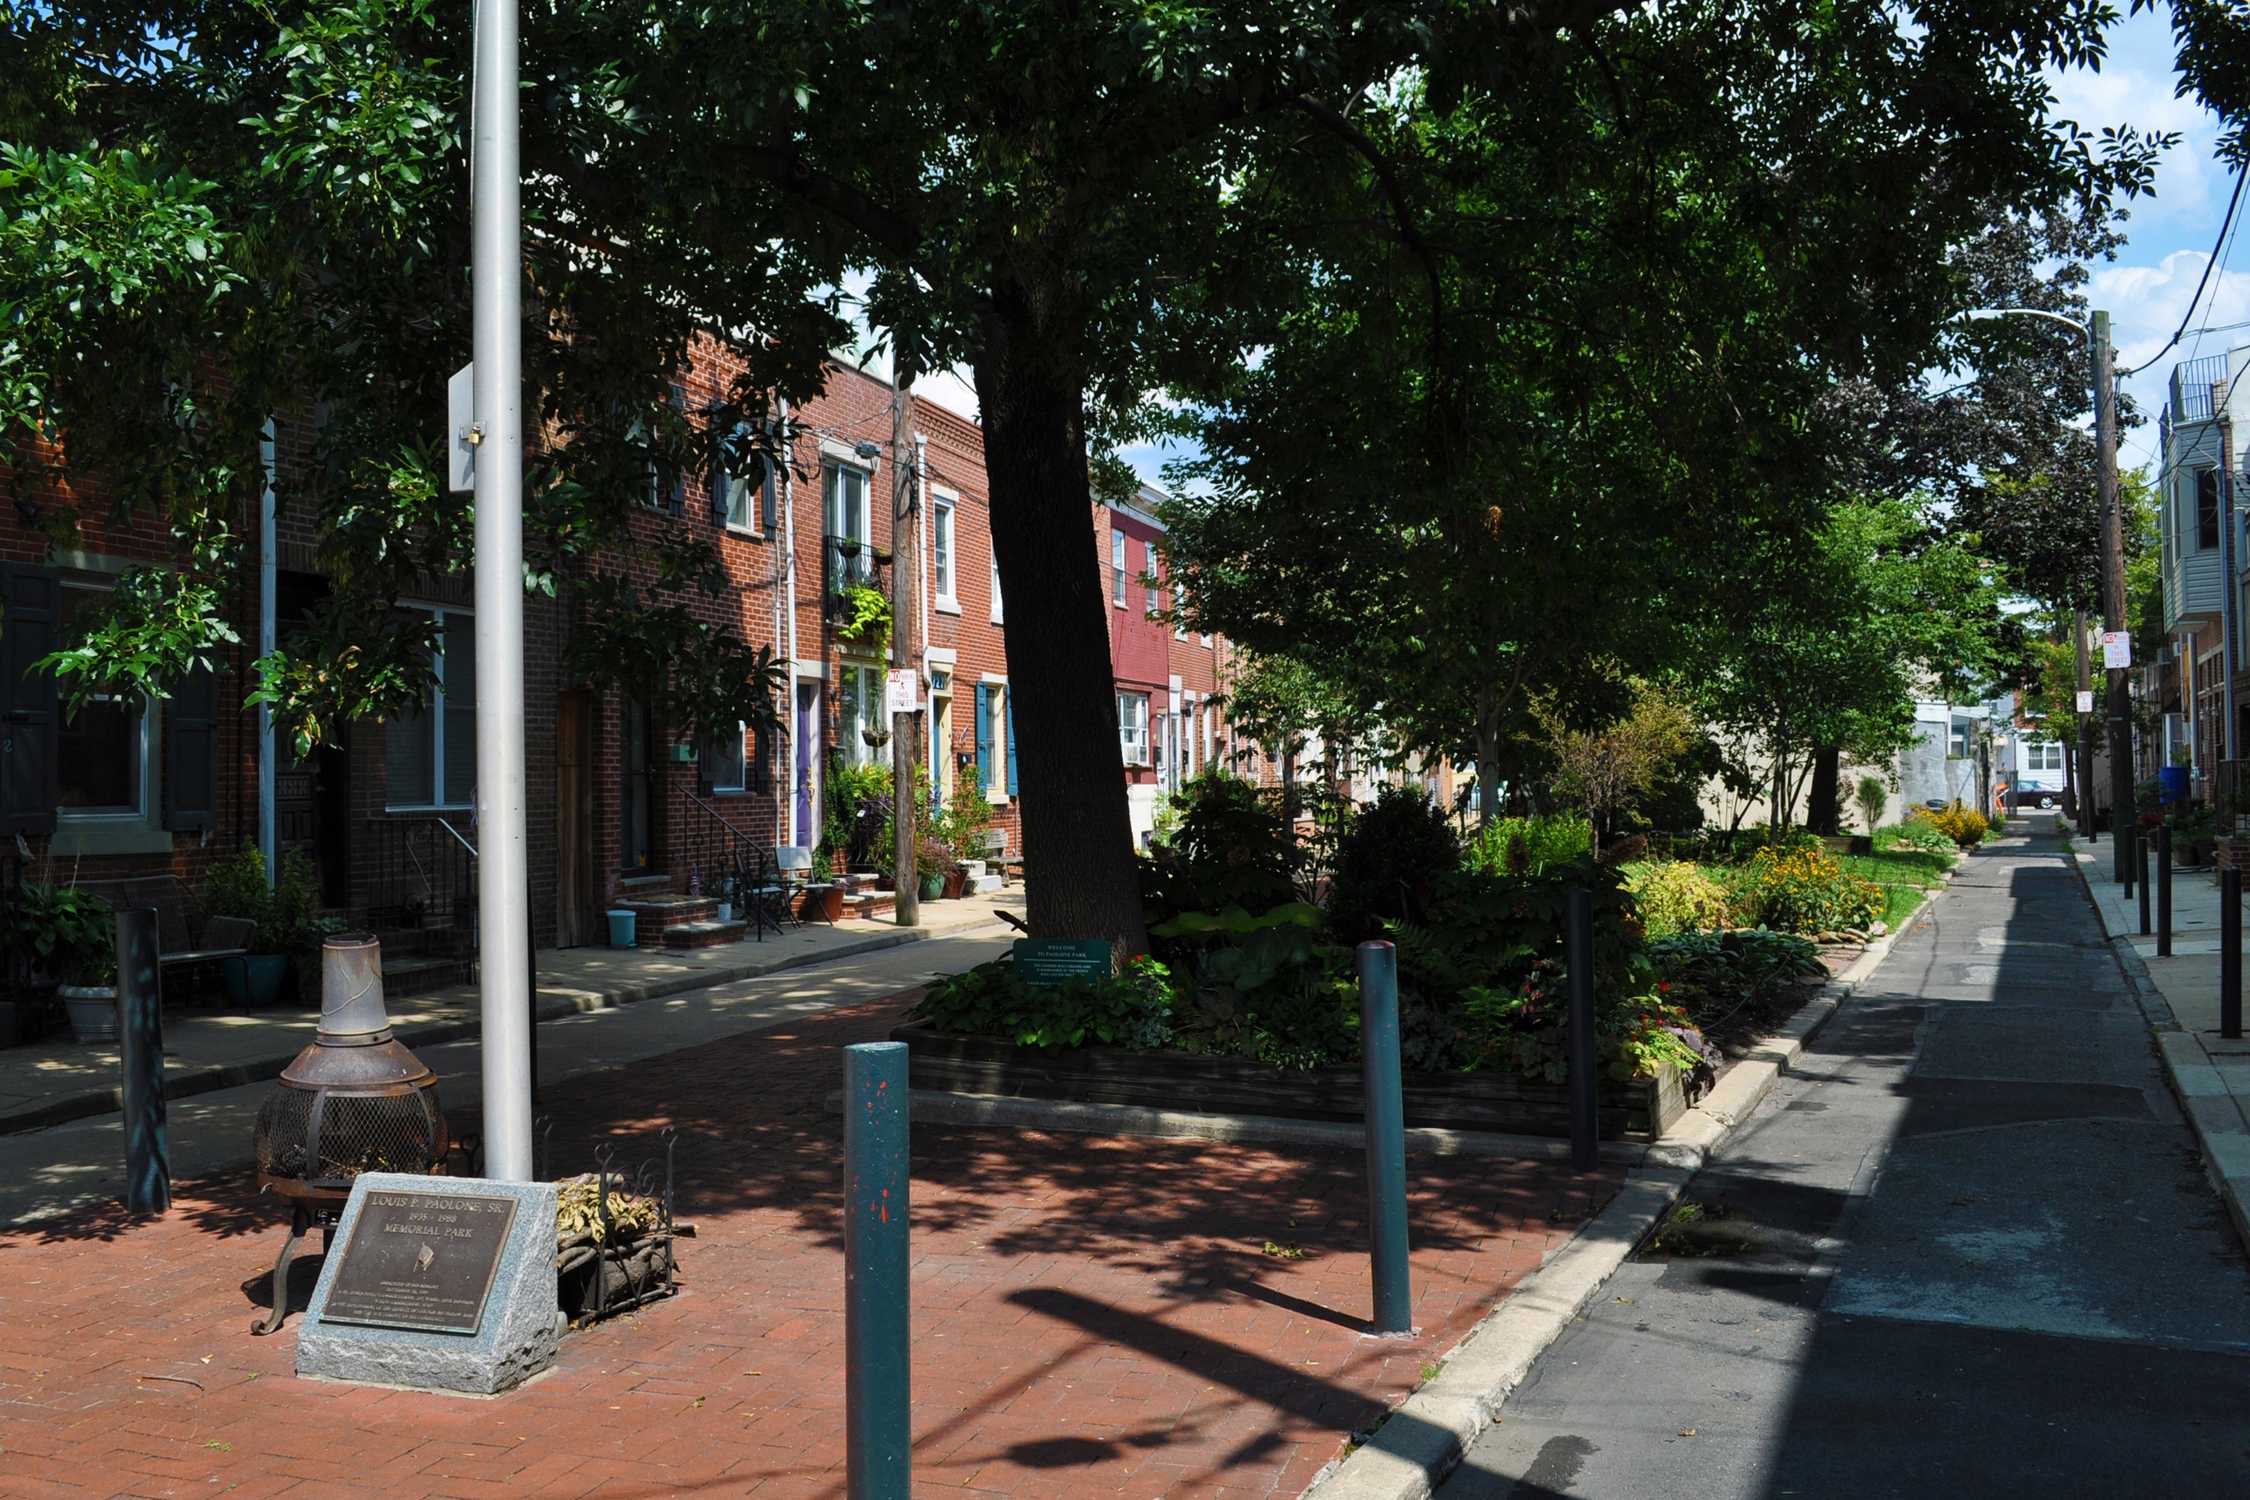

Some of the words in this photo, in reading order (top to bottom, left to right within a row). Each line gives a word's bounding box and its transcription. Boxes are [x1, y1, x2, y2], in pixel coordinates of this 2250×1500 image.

[889, 671, 900, 682] NO
[371, 1195, 408, 1207] LOUIS
[384, 1224, 440, 1235] MEMORIAL
[444, 1227, 473, 1238] PARK
